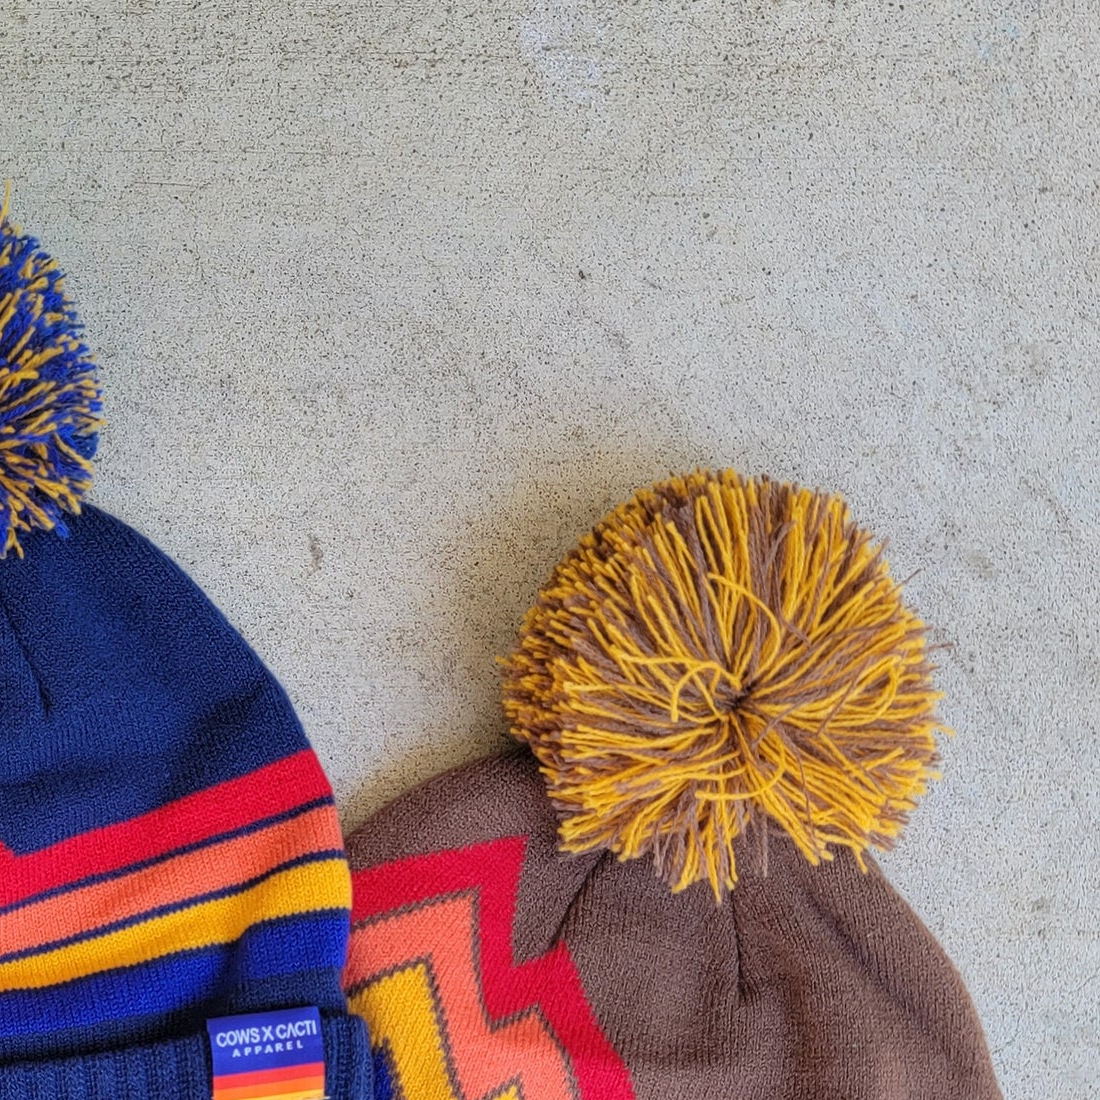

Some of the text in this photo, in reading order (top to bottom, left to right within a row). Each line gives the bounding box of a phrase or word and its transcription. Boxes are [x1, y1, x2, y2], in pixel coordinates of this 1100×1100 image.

[216, 1019, 317, 1047] COWS X CACTI
[232, 1040, 303, 1058] APPAREL
